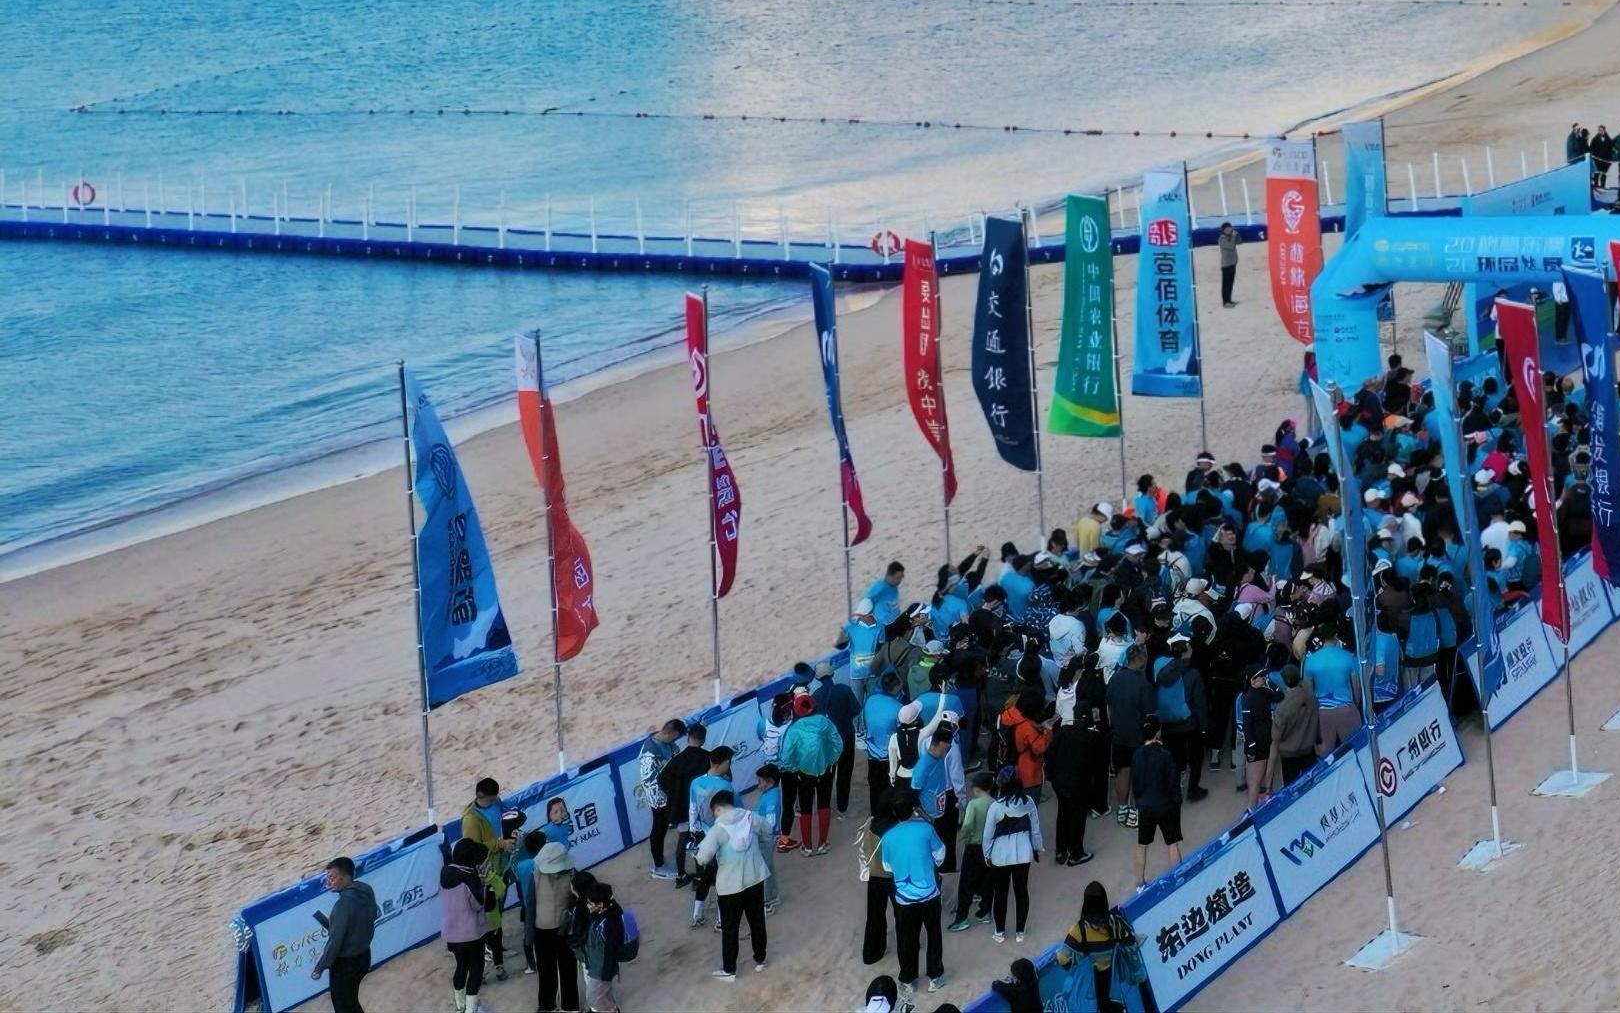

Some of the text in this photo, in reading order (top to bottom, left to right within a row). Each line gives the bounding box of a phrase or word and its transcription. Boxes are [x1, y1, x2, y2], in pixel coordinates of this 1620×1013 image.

[1084, 260, 1102, 395] 中国农业银行
[1153, 252, 1180, 353] 壹佰体育
[1176, 911, 1254, 981] DONG PLANT
